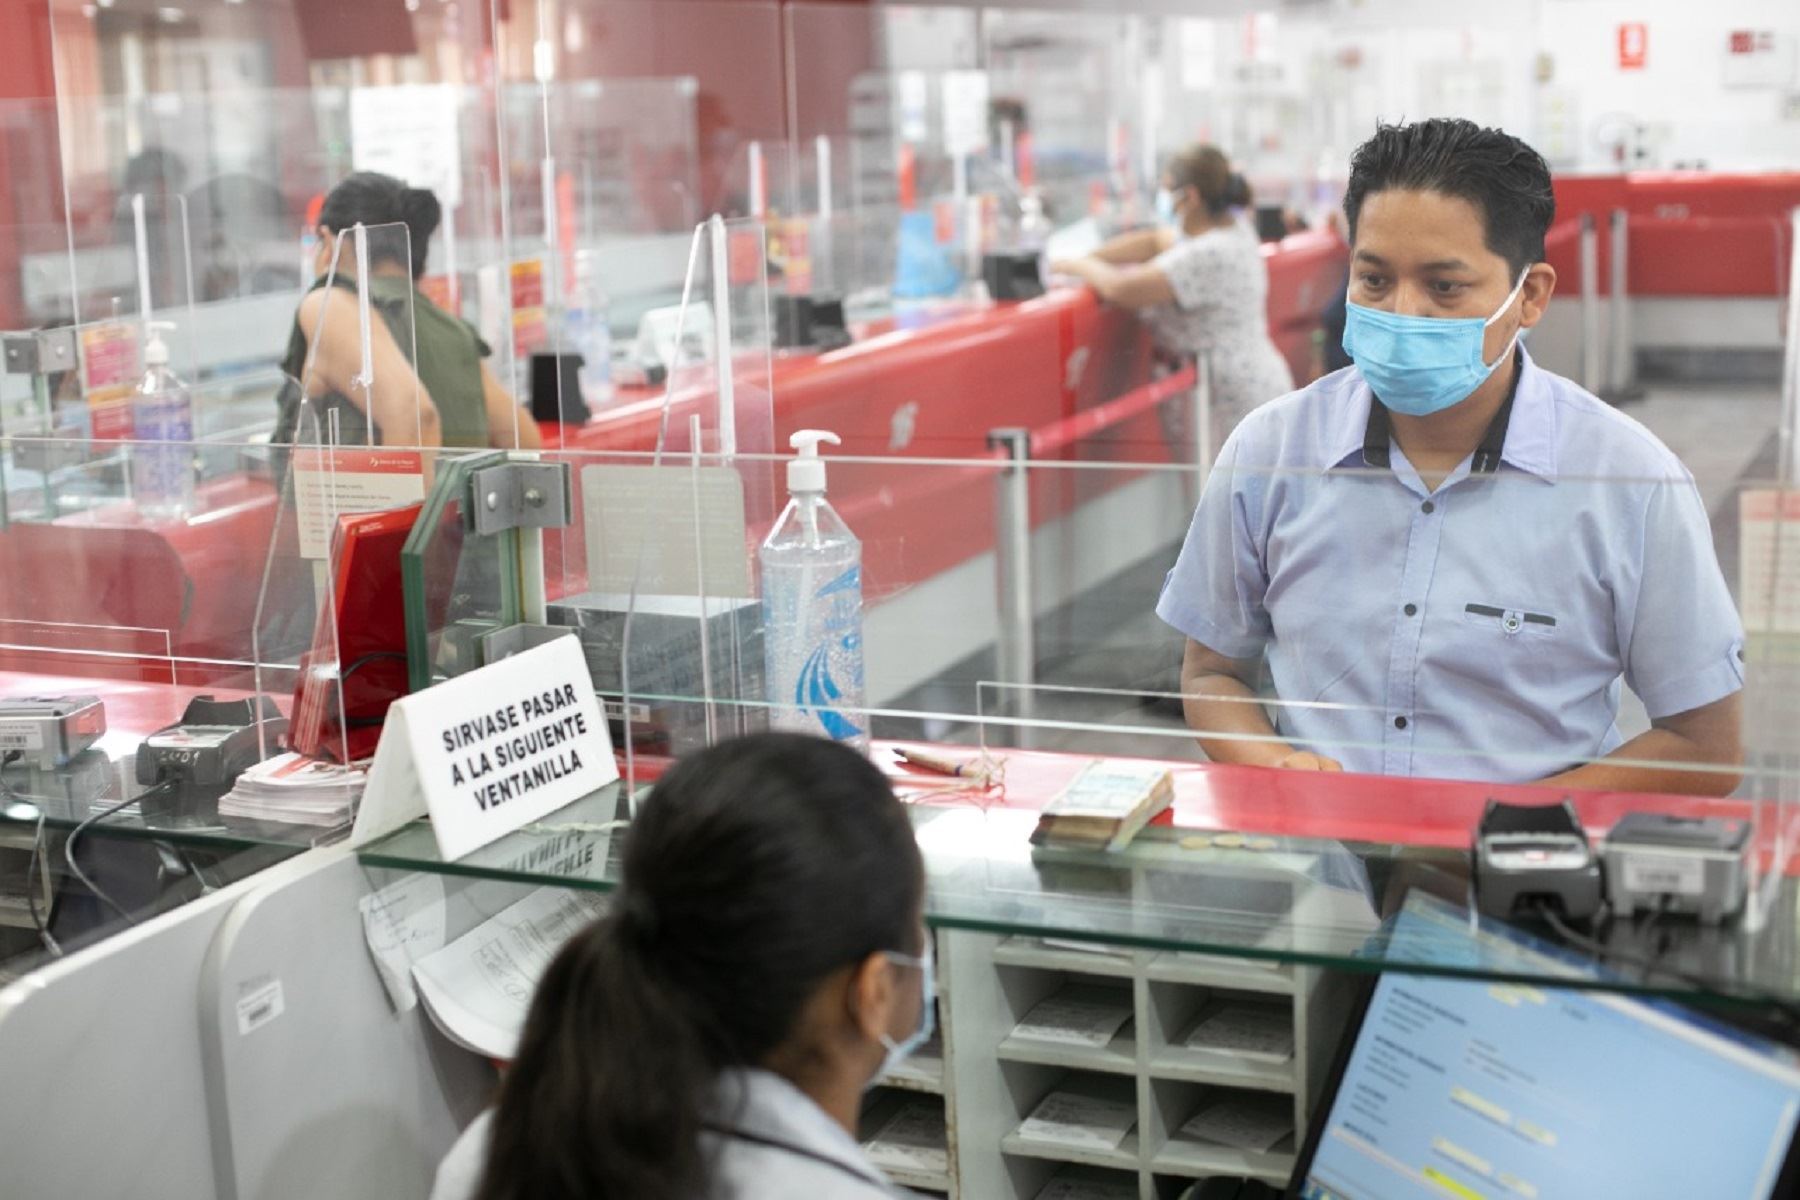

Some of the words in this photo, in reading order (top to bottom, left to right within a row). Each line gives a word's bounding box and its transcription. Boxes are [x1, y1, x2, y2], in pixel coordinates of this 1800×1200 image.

[443, 706, 519, 752] SIRVASE
[522, 684, 578, 722] PASAR
[453, 765, 465, 786] A
[468, 753, 493, 779] LA
[496, 713, 587, 767] SIGUIENTE
[475, 749, 583, 811] VENTANILLA
